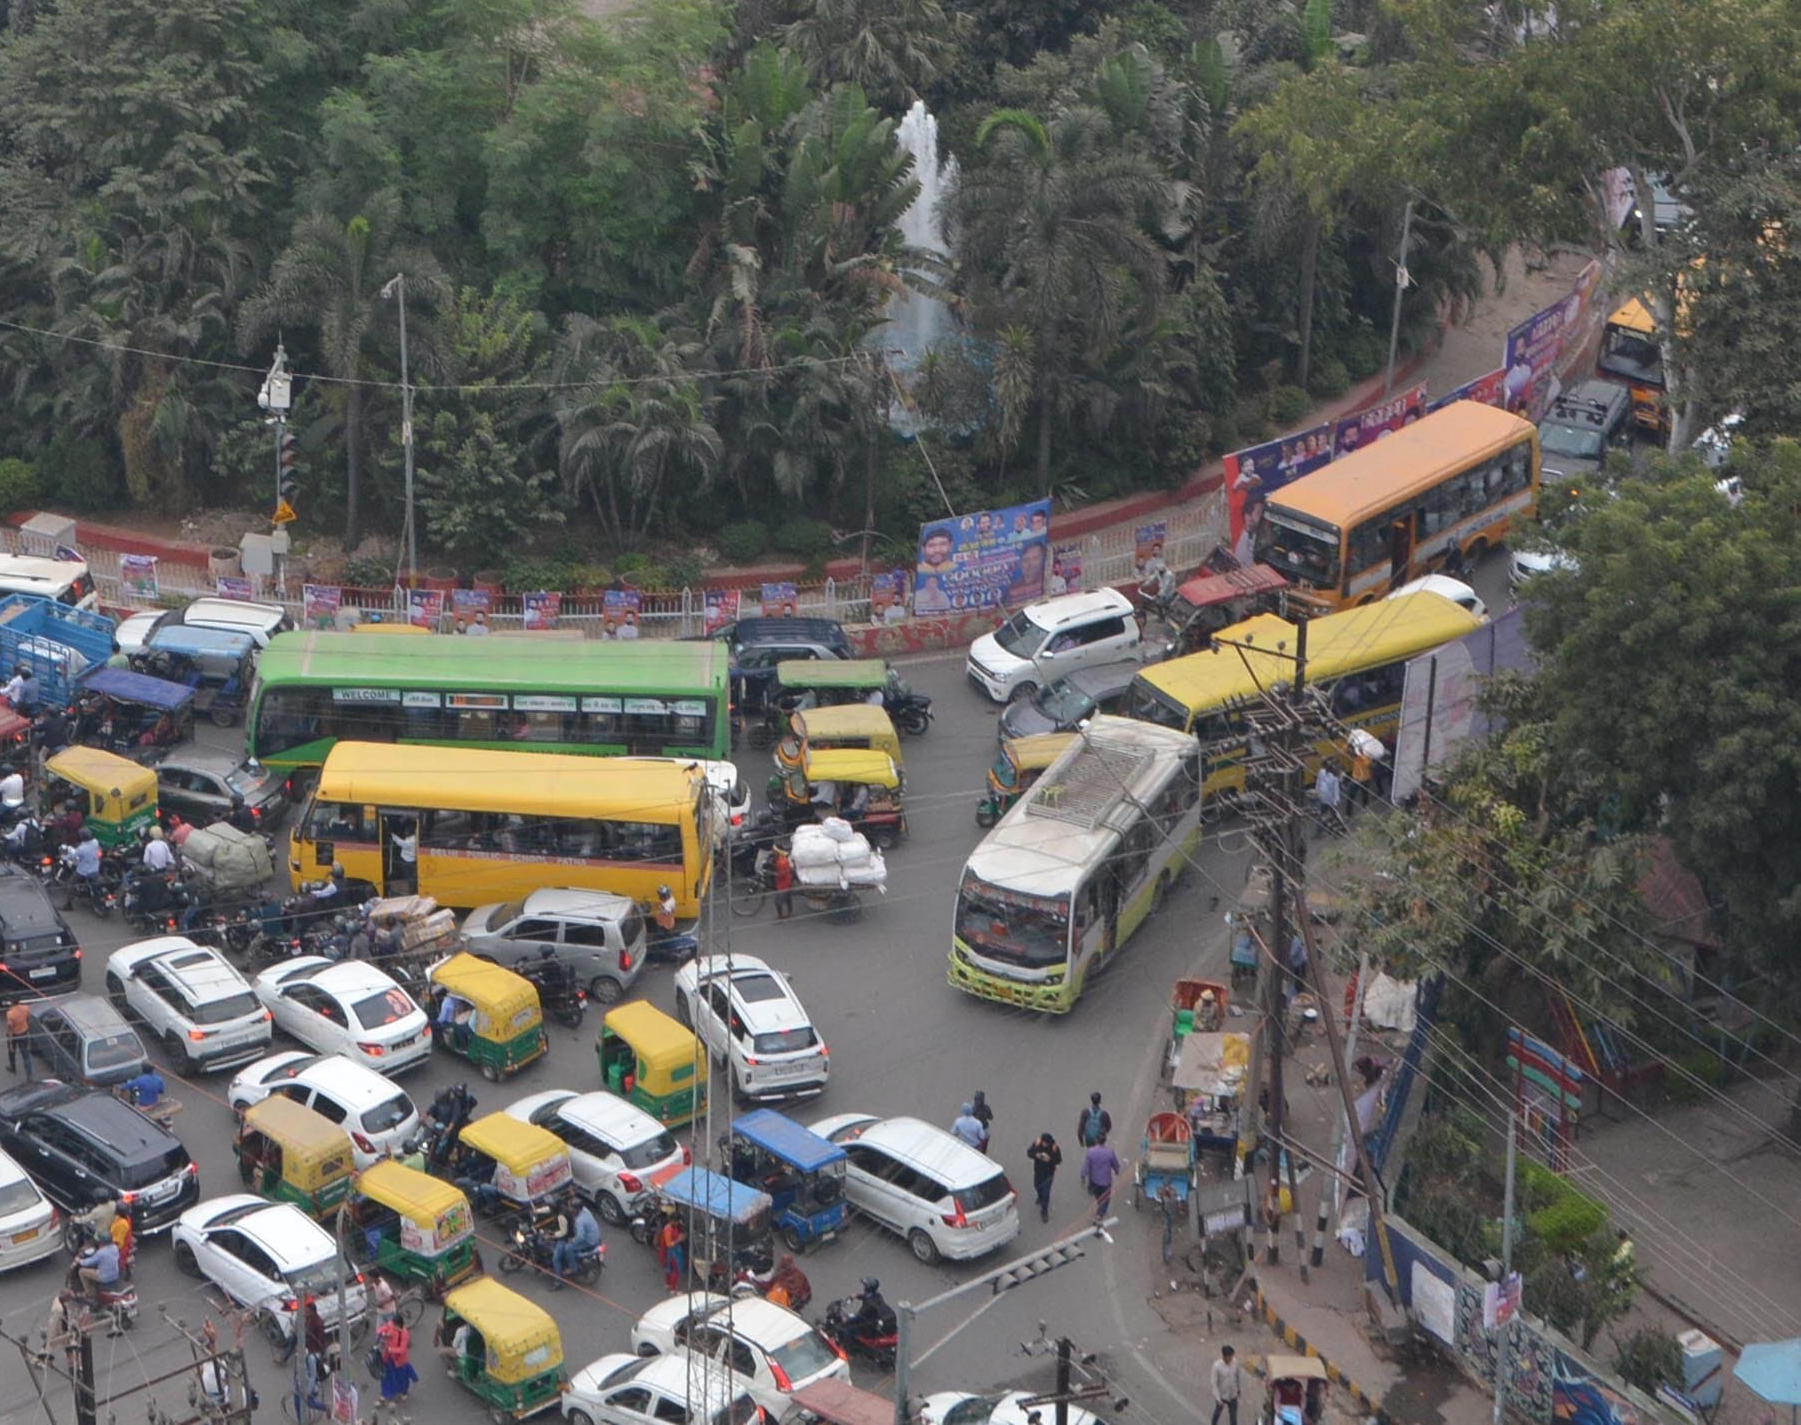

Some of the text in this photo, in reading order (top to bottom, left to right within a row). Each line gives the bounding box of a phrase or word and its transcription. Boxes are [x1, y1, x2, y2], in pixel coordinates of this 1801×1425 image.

[342, 689, 393, 700] WELCOME
[430, 848, 460, 858] DELHI
[466, 850, 502, 862] PUBLIC
[509, 853, 548, 865] SCHOOL
